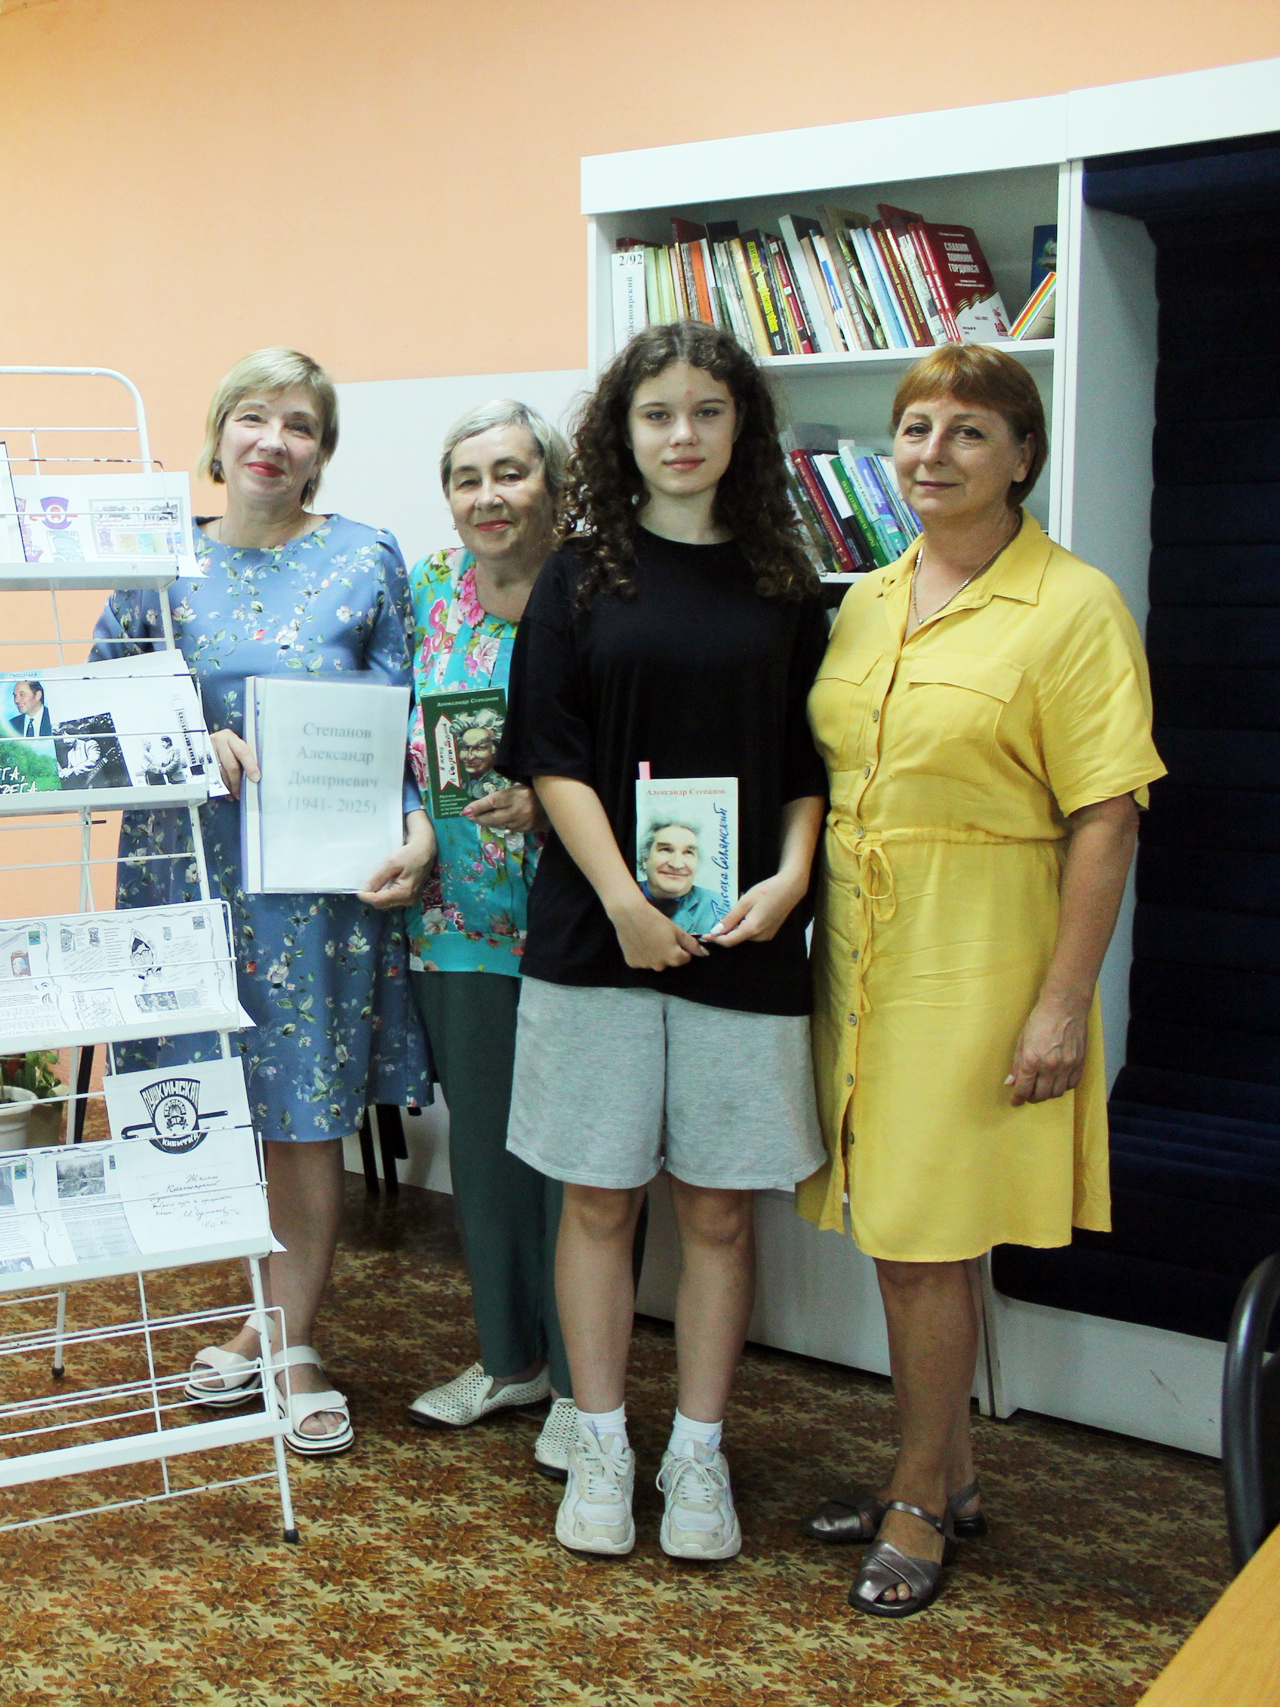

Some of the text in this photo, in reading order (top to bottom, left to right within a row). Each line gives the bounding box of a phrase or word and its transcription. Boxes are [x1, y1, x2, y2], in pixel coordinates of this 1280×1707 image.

[619, 254, 643, 266] 2/92
[303, 722, 372, 739] Степанов
[297, 746, 374, 765] Александр
[288, 770, 378, 789] Дмитриевич
[646, 789, 687, 797] Александр
[337, 798, 377, 816] 2025)
